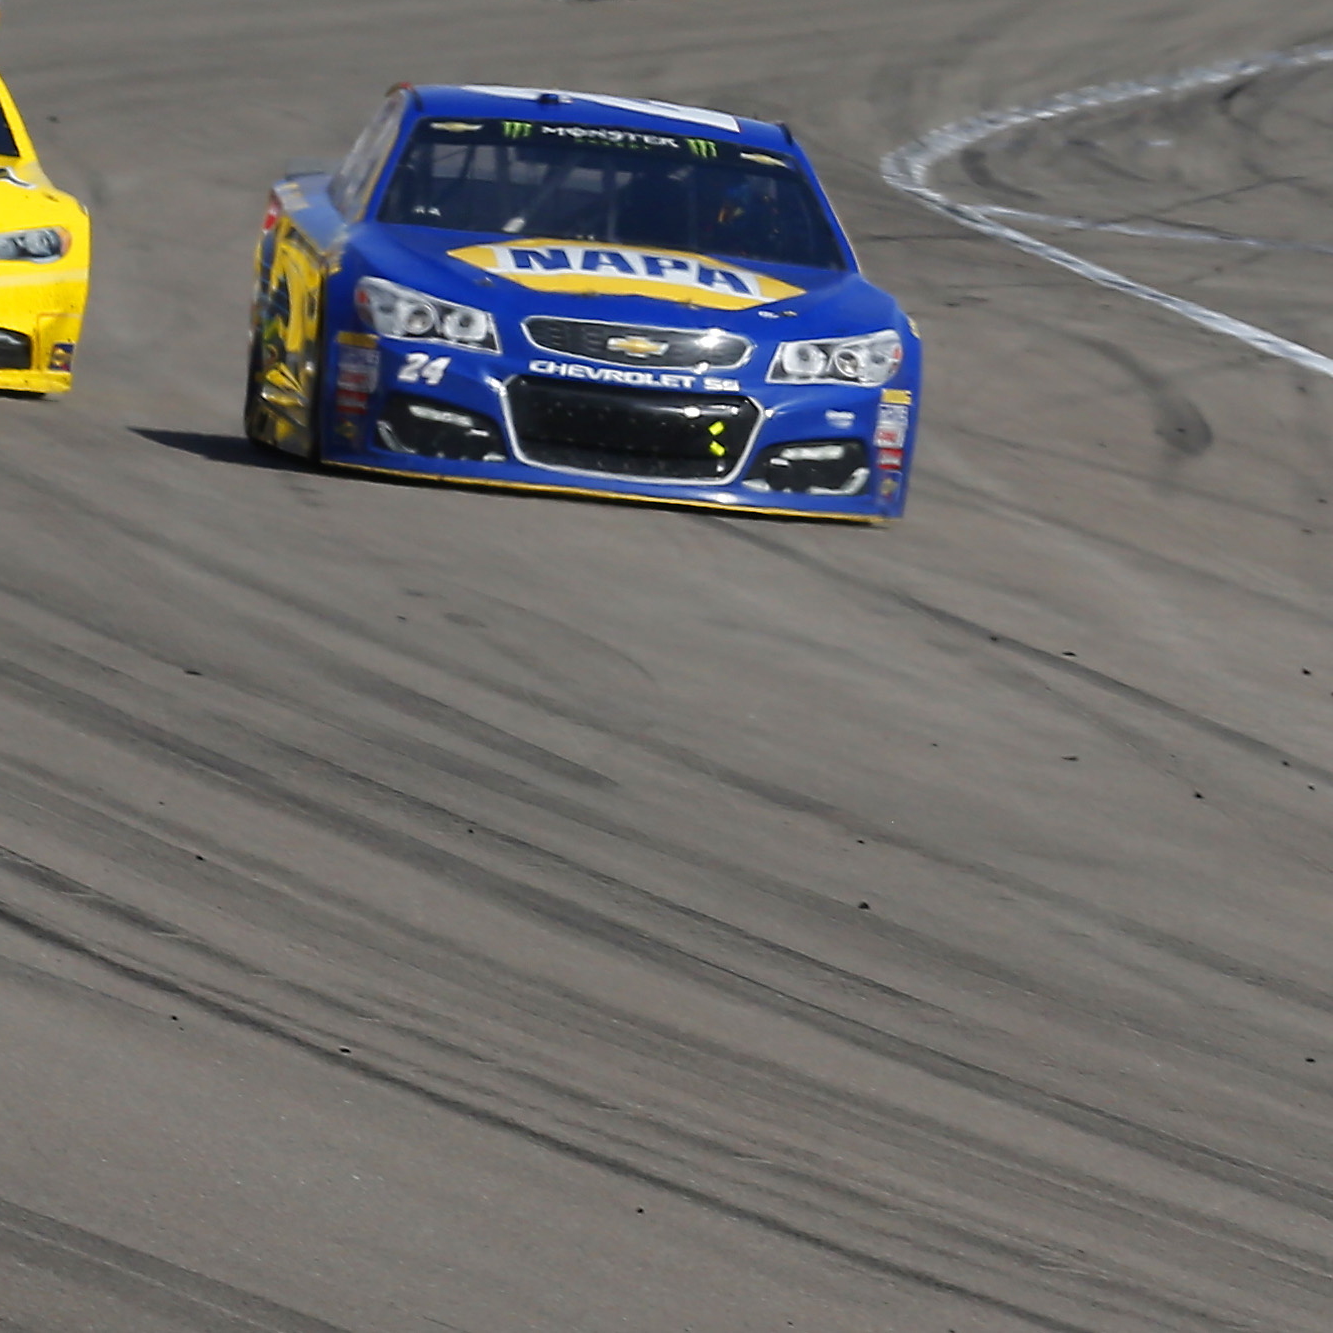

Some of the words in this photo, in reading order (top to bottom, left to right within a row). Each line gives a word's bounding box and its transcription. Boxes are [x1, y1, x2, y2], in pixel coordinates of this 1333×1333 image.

[540, 126, 681, 149] MONSTER
[511, 248, 751, 295] NAPA
[396, 352, 452, 386] 24
[529, 359, 696, 389] CHEVROLET
